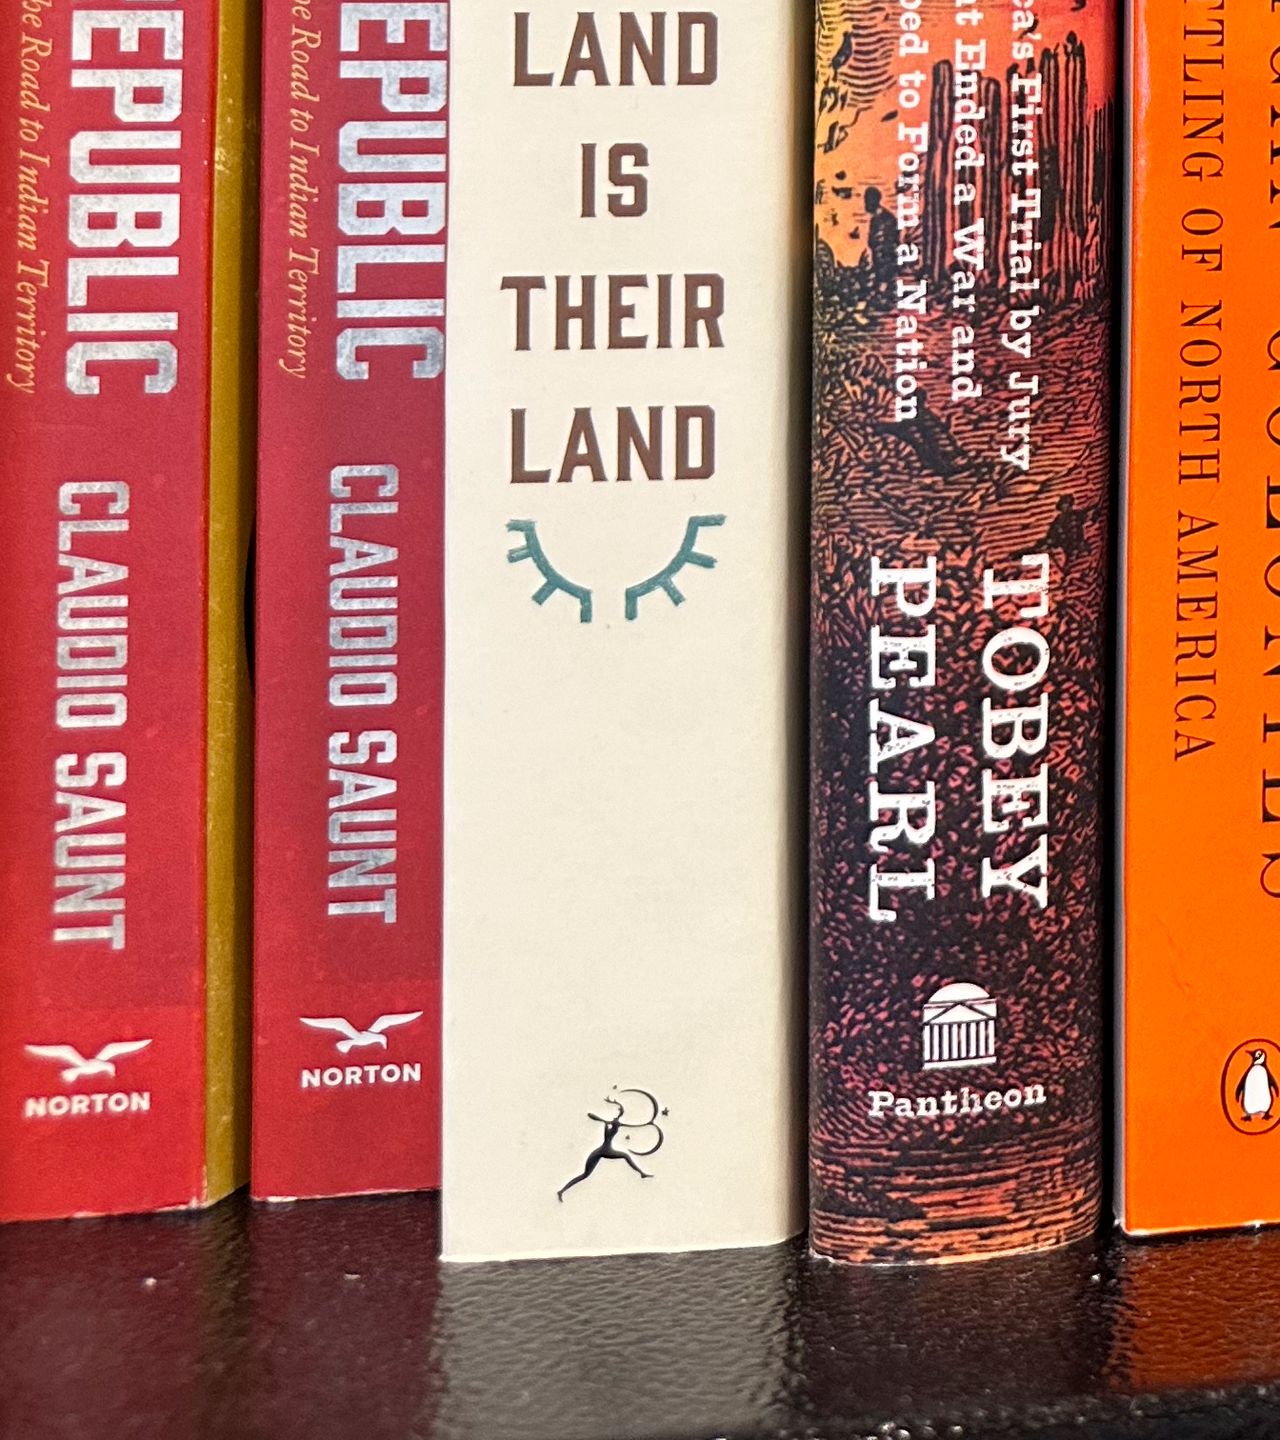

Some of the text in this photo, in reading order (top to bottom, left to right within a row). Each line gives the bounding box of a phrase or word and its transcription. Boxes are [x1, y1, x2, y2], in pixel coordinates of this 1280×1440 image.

[290, 23, 323, 103] Road
[512, 11, 719, 88] LAND
[897, 64, 928, 110] to
[953, 34, 987, 168] Ended
[289, 107, 315, 133] to
[1010, 71, 1043, 178] First
[287, 136, 321, 240] Indian
[580, 142, 650, 219] IS
[896, 118, 929, 231] Form
[953, 181, 977, 205] a
[896, 242, 918, 264] a
[951, 213, 986, 317] War
[1009, 183, 1042, 298] Trial
[1181, 208, 1224, 273] OF
[278, 246, 321, 380] Territory
[499, 272, 726, 352] THEIR
[894, 274, 929, 423] Nation
[951, 323, 983, 402] and
[1003, 303, 1041, 360] by
[1000, 366, 1040, 472] Jury
[1178, 298, 1224, 485] NORTH
[509, 404, 717, 484] LAND
[55, 478, 131, 733] CLAUDIO
[325, 460, 401, 710] CLAUDIO
[1173, 509, 1220, 762] AMERICA
[868, 555, 938, 924] PEARL
[980, 552, 1050, 912] TOBEY
[50, 749, 128, 951] SAUNT
[325, 728, 399, 925] SAUNT
[24, 1090, 152, 1119] NORTON
[300, 1059, 422, 1090] NORTON
[867, 1081, 1048, 1119] Pantheon
